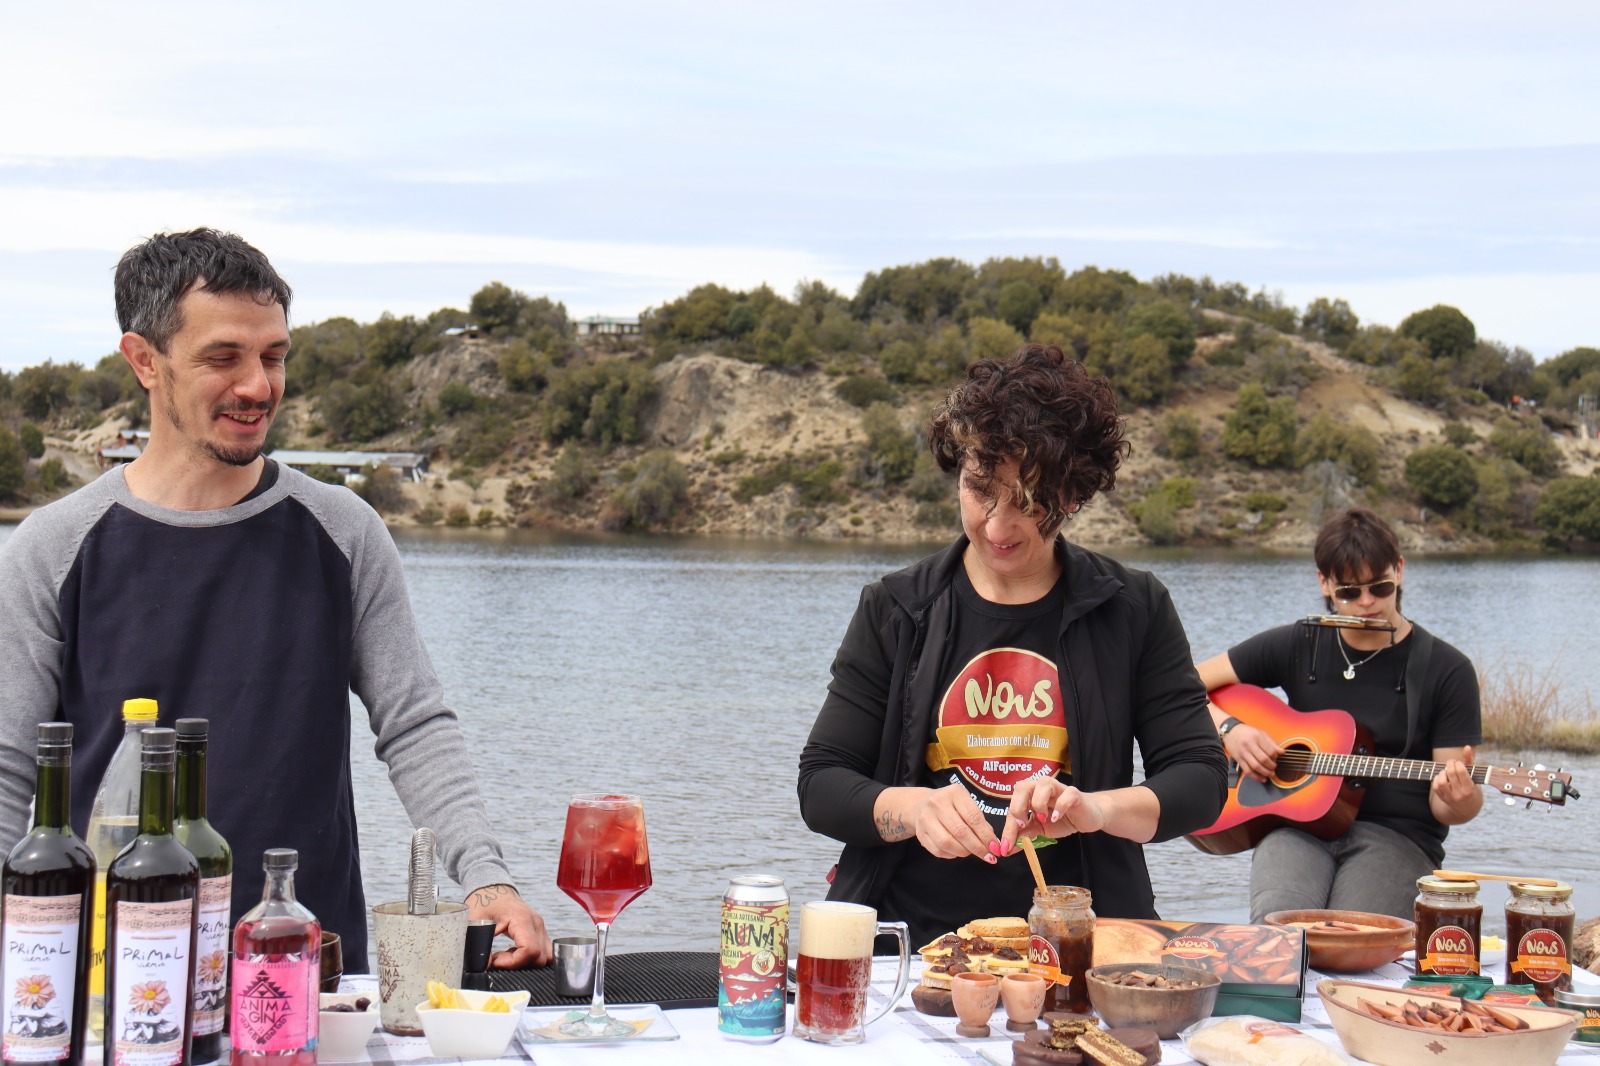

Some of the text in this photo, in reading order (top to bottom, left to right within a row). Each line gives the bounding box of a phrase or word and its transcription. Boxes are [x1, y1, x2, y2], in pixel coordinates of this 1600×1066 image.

[966, 733, 1050, 749] Elaboramos con el Alma
[965, 766, 980, 781] con
[979, 776, 1012, 792] harina
[197, 920, 230, 934] PRiMa
